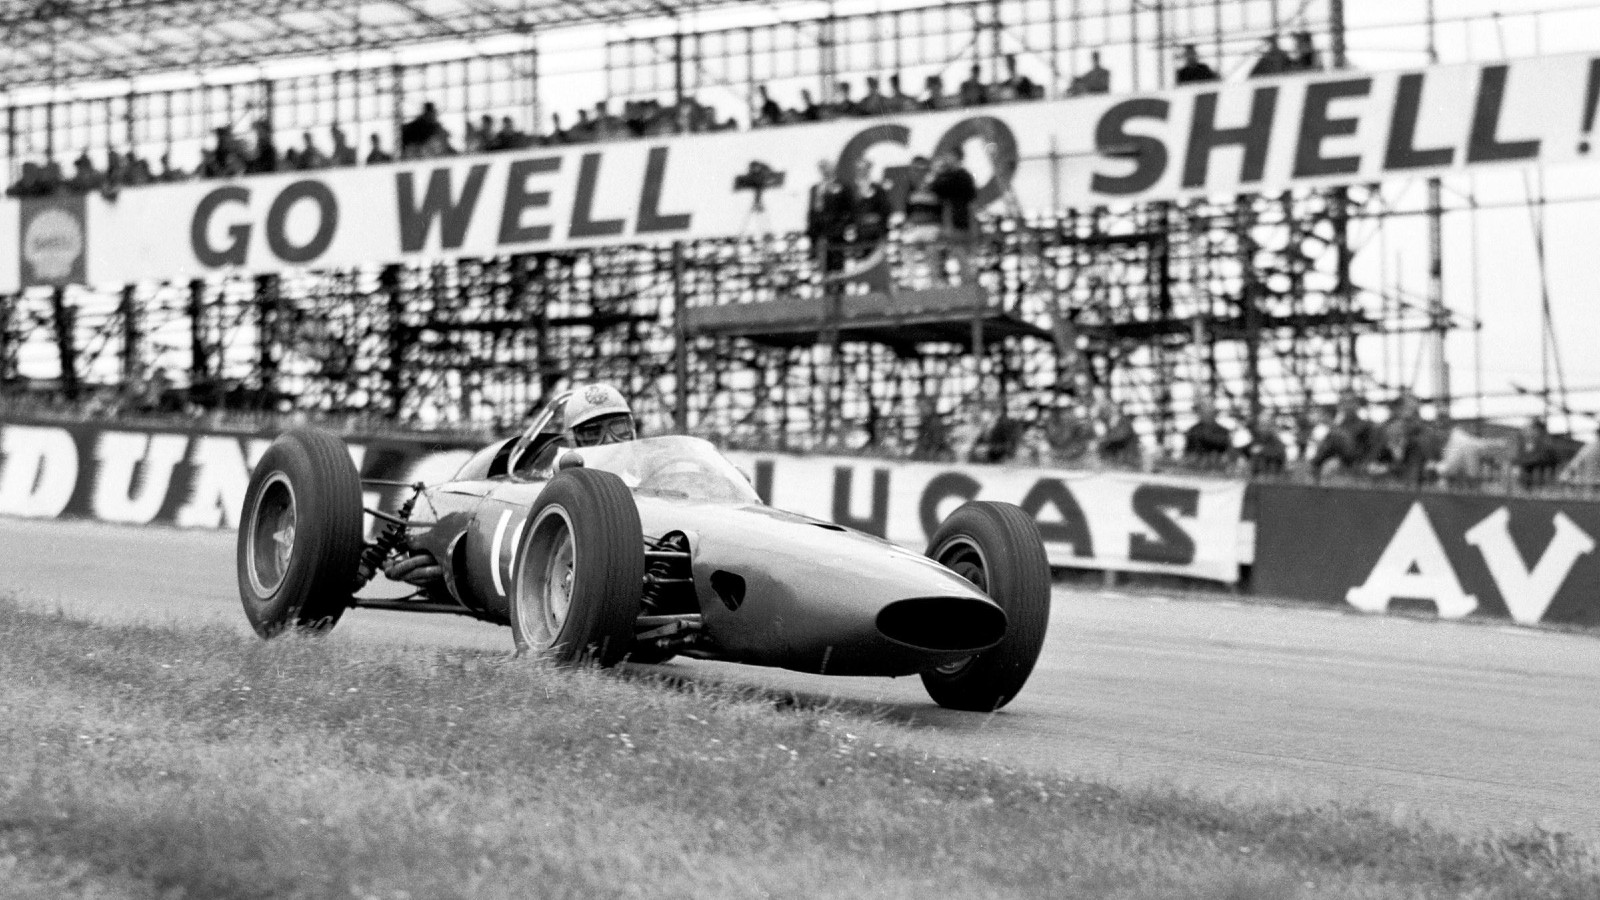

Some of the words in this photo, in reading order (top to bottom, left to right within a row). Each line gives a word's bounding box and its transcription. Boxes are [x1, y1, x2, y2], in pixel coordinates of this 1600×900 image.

[190, 179, 339, 269] GO
[395, 145, 693, 252] WELL
[1345, 501, 1596, 626] AV
